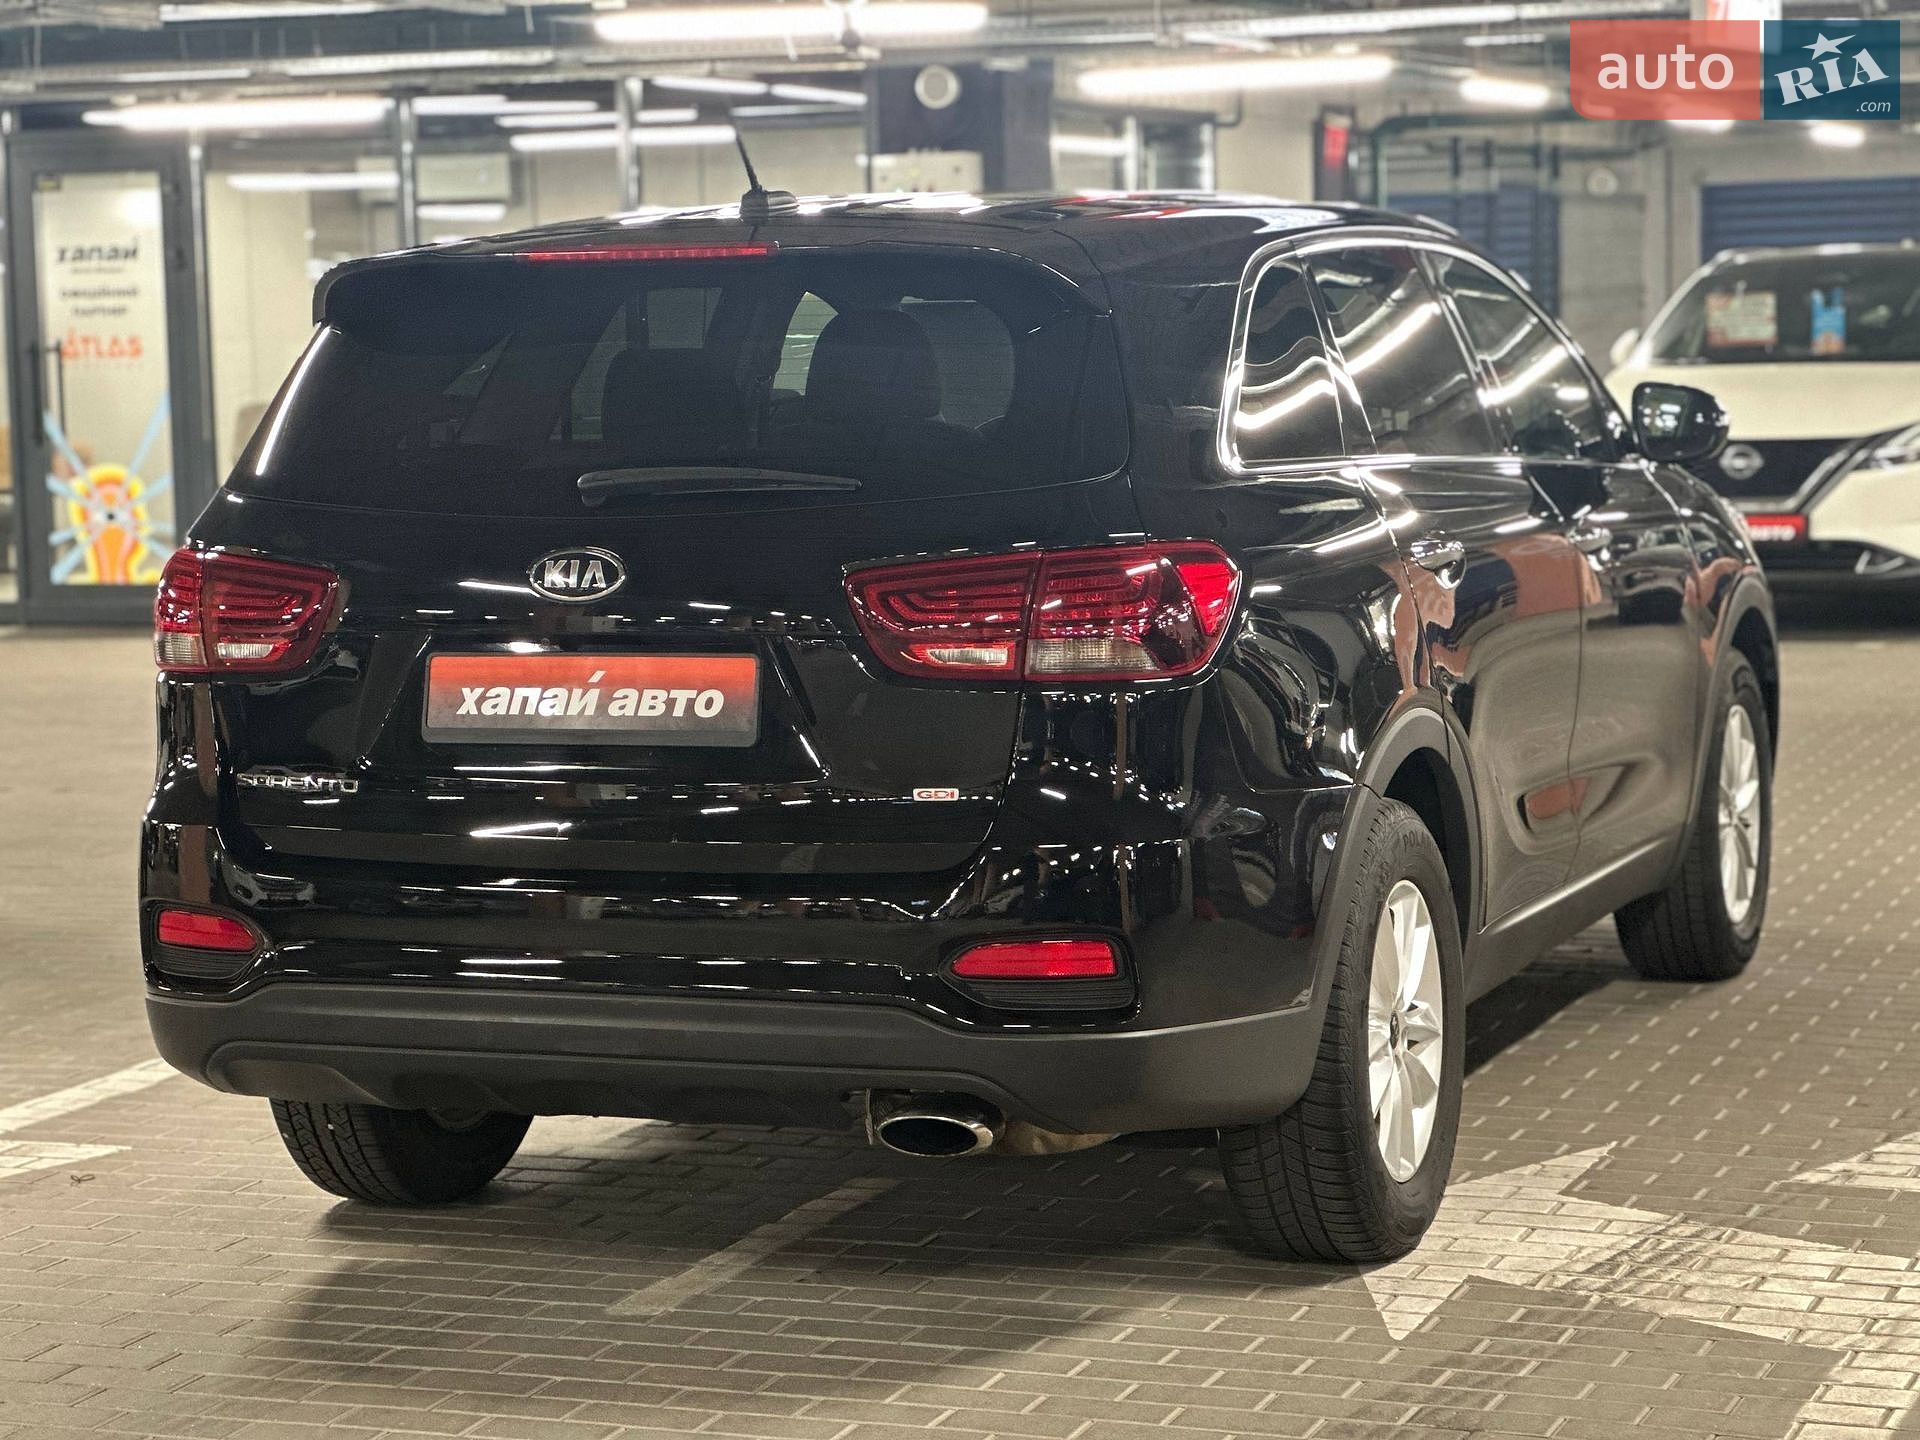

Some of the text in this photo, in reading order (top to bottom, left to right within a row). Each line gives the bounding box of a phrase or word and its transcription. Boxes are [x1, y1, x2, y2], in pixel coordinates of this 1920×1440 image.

[544, 559, 607, 588] KIA
[456, 670, 726, 718] хапай авто
[236, 773, 360, 793] SORENTO
[916, 790, 955, 799] GDI
